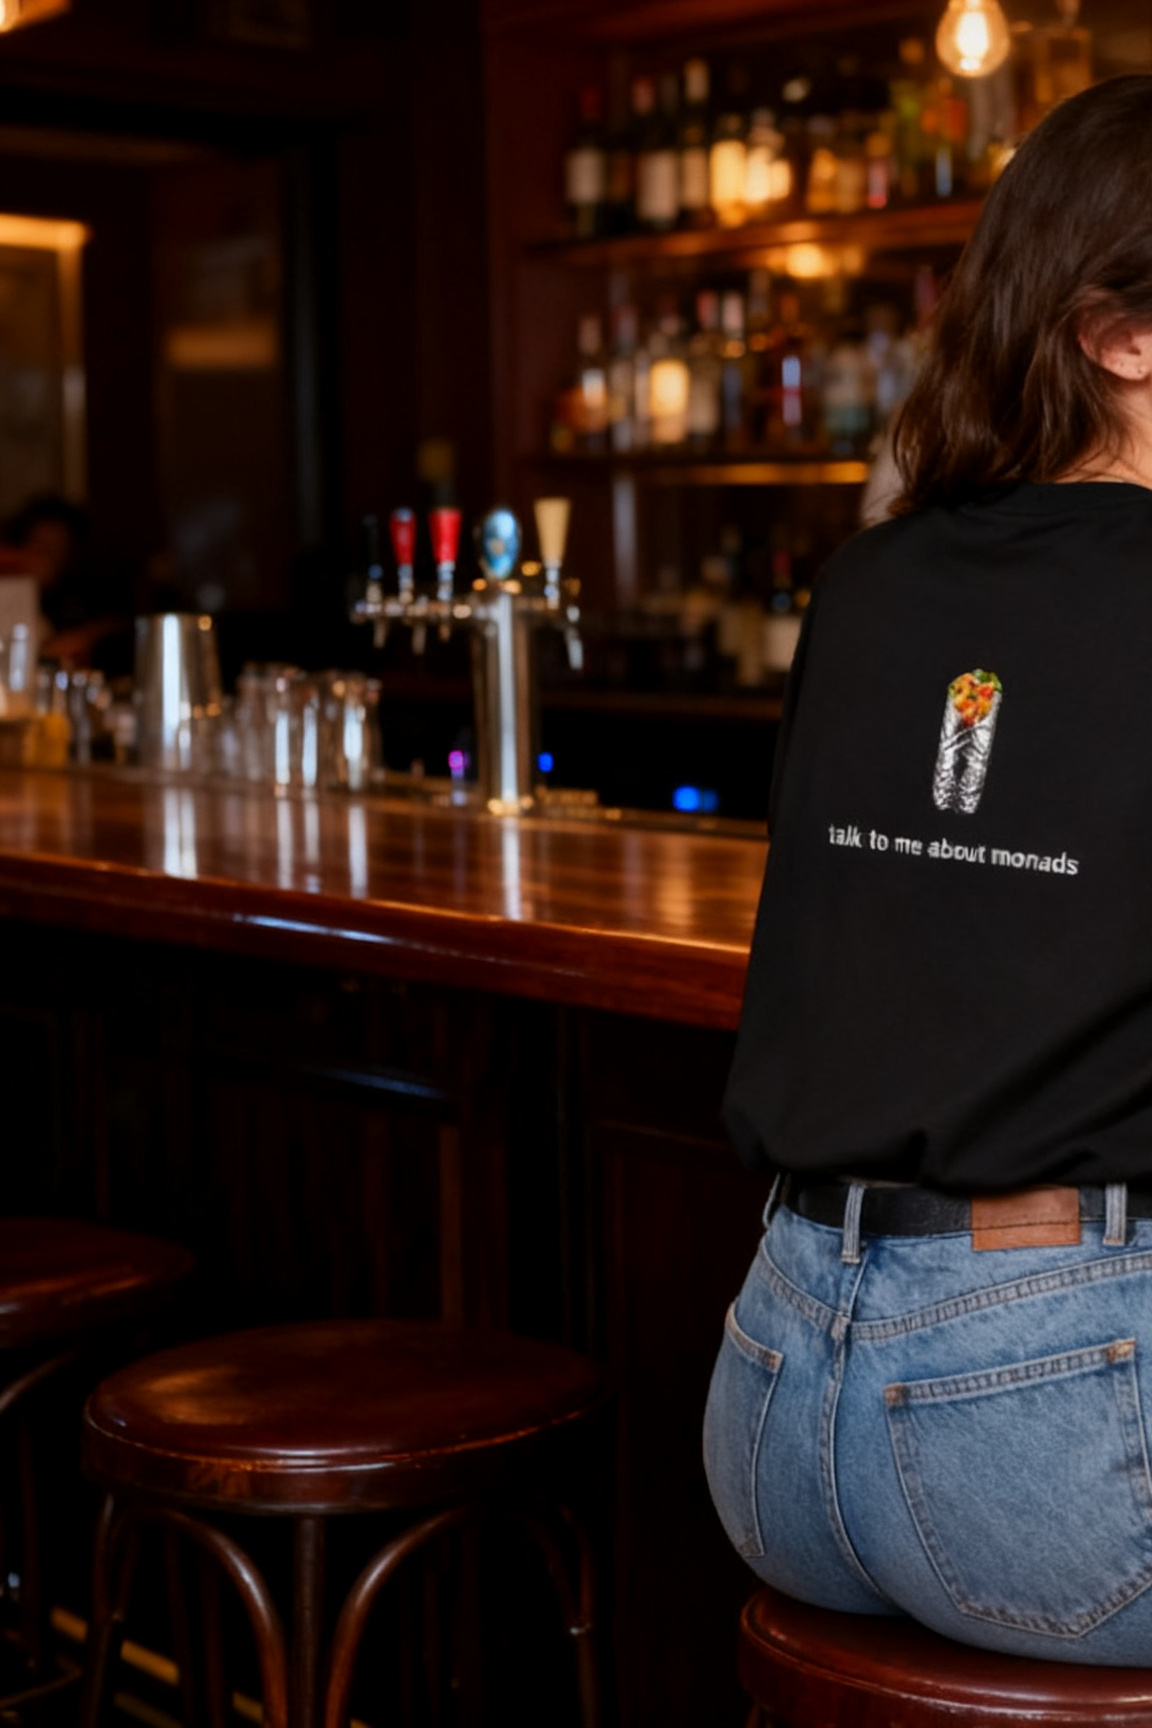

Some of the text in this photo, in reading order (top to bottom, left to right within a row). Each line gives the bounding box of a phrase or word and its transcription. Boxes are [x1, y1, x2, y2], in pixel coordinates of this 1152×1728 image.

[828, 824, 1080, 876] talk to me about monads
